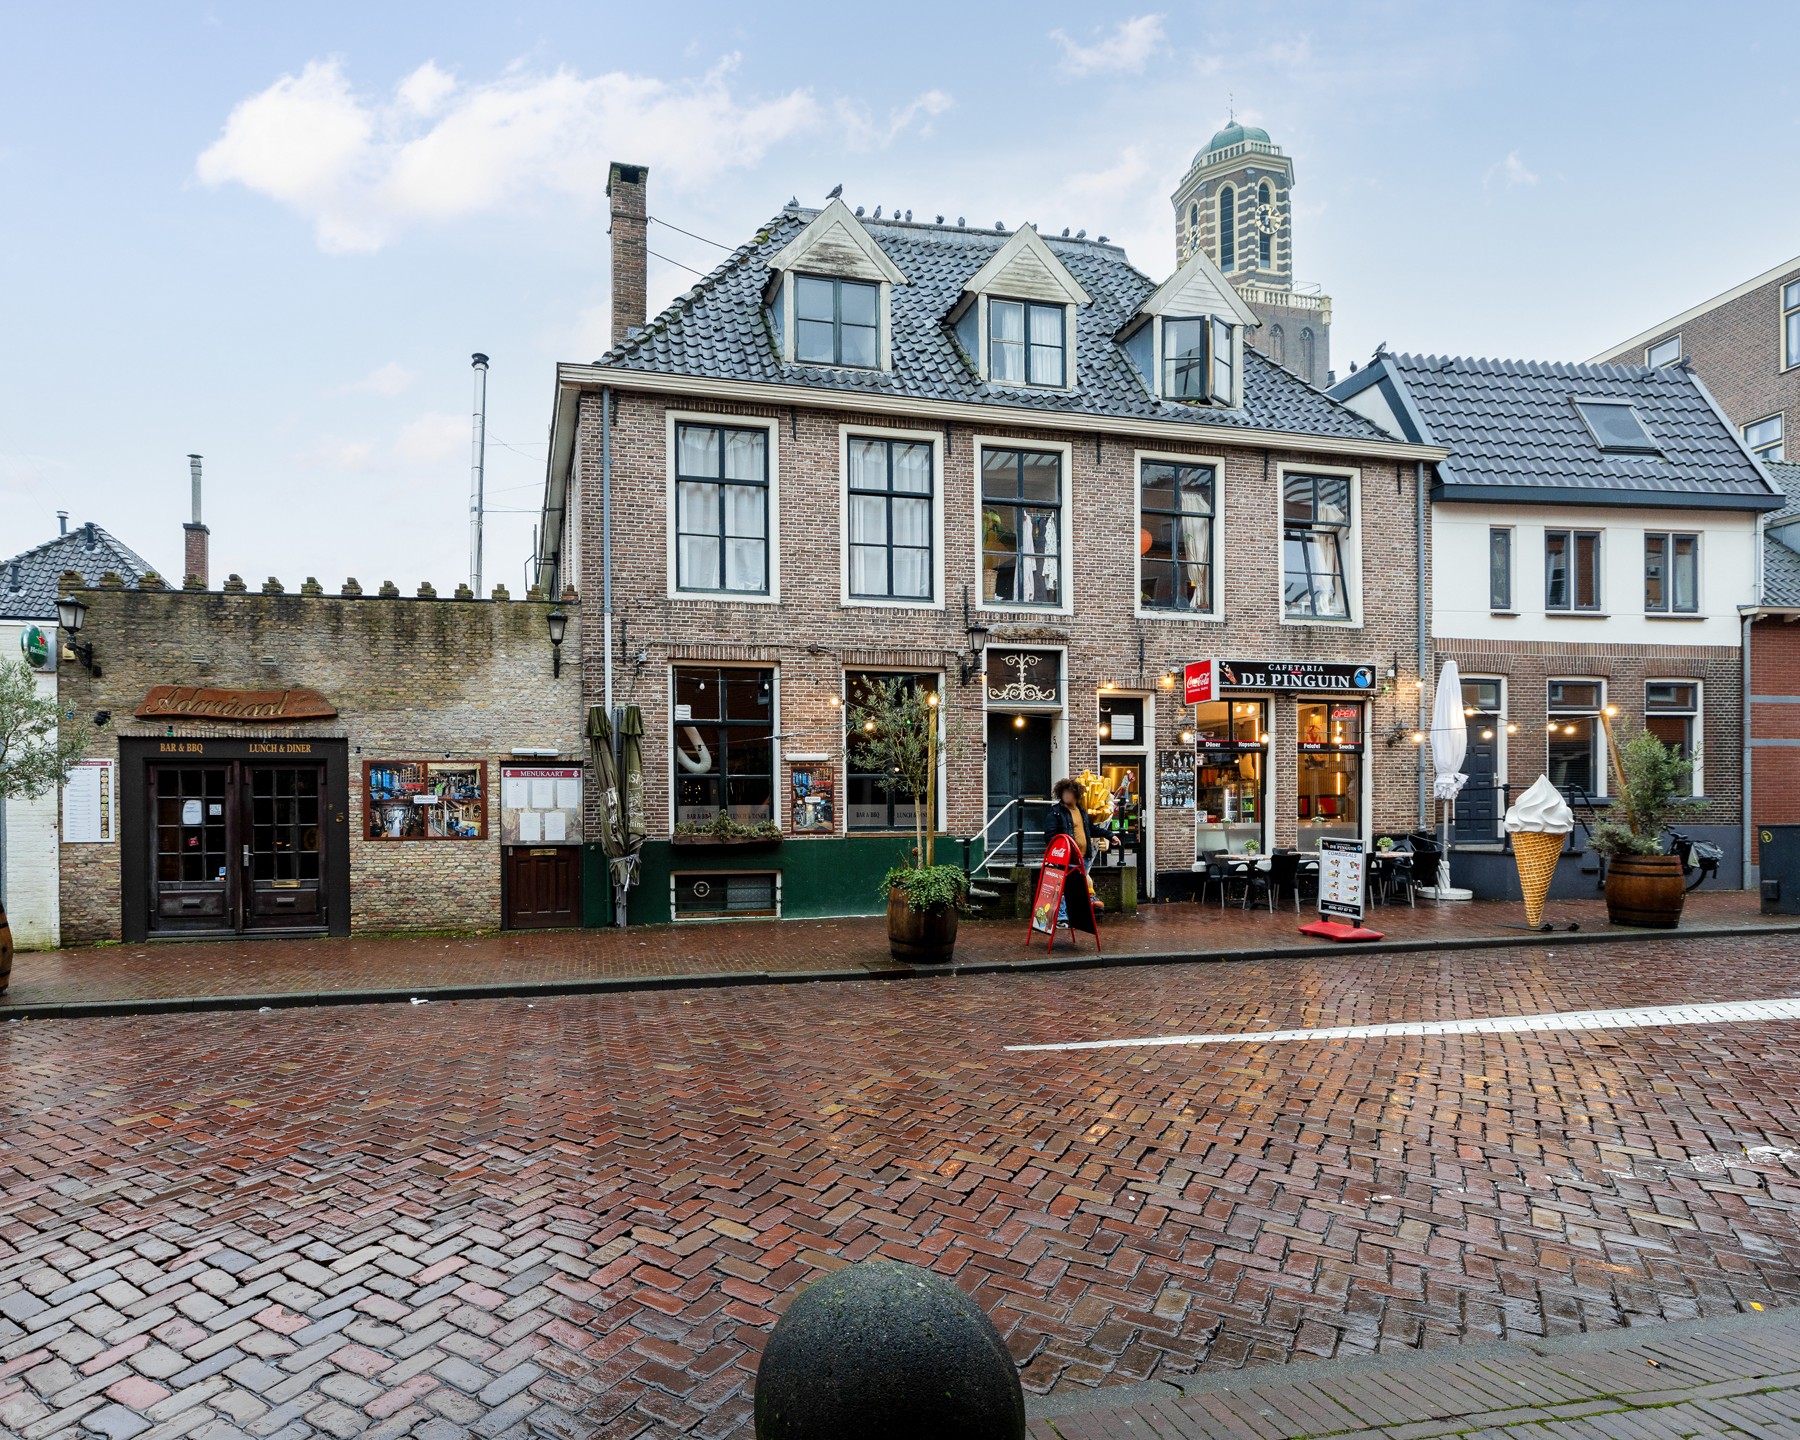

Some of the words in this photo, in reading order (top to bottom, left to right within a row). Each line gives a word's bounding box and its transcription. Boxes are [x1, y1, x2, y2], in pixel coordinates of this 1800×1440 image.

[1268, 664, 1324, 672] CAFETARIA
[1241, 673, 1267, 686] DE
[1271, 673, 1350, 688] PINGUIN
[145, 686, 291, 717] Admiraal
[1333, 709, 1357, 719] OPEN
[160, 743, 177, 752] BAR
[178, 743, 185, 752] &
[186, 743, 203, 754] BBQ
[249, 743, 277, 753] LUNCH
[279, 743, 285, 753] &
[286, 744, 312, 753] DINER
